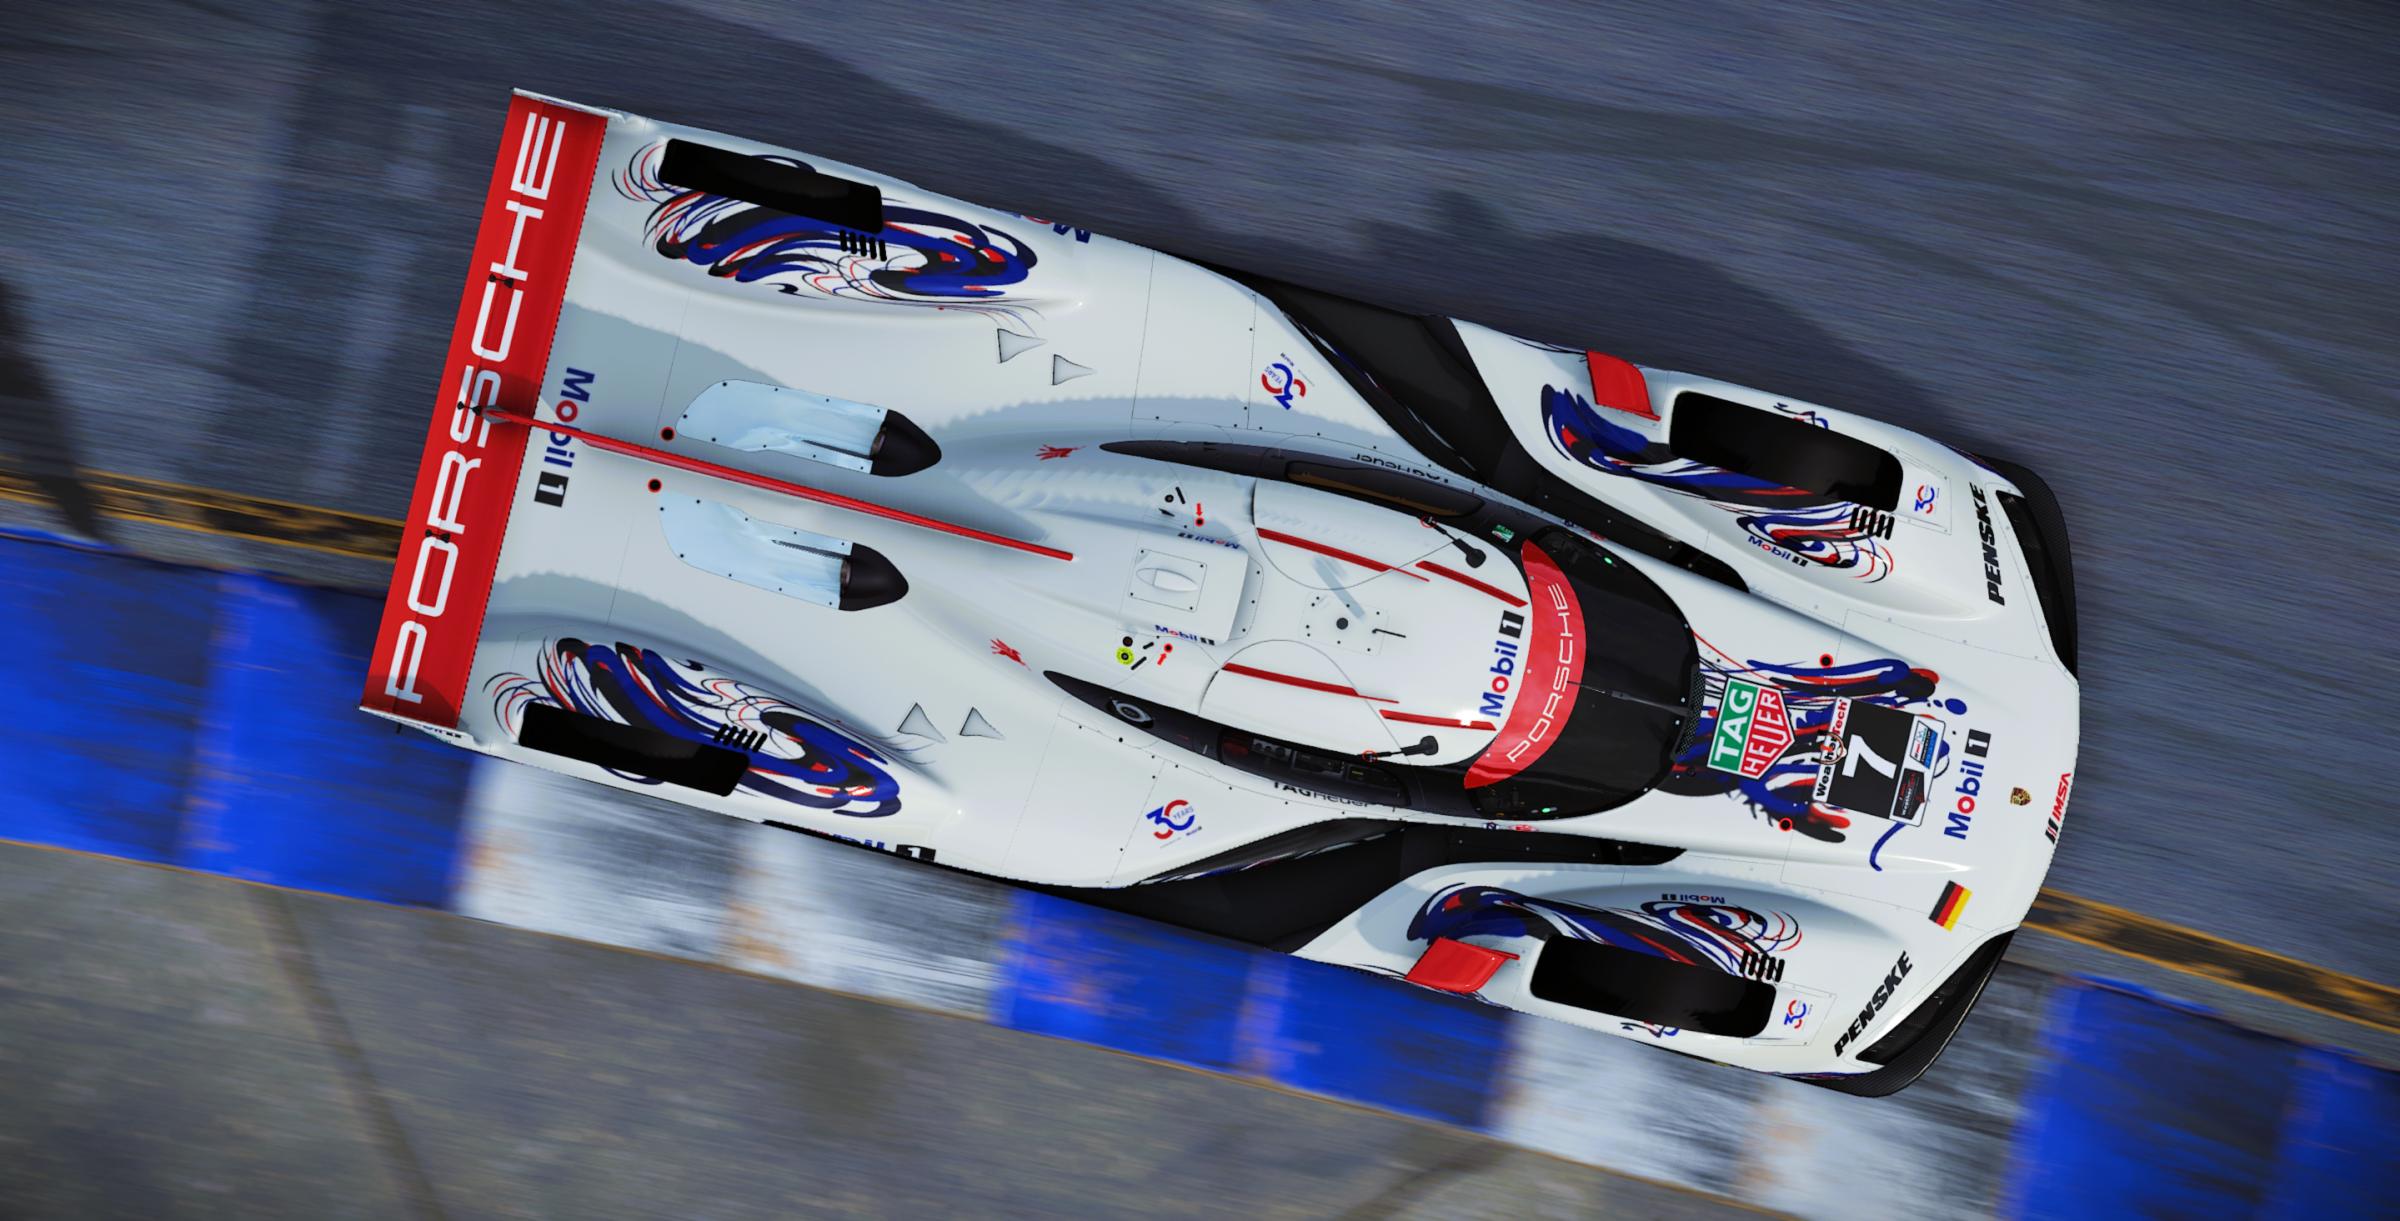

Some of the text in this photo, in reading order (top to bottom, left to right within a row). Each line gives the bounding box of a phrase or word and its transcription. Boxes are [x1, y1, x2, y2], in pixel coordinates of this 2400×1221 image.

[384, 111, 566, 704] PORSCHE
[543, 366, 596, 468] Mobil
[1262, 363, 1306, 410] 30
[1914, 484, 1935, 514] 30
[1748, 535, 1791, 560] Mobil
[1968, 481, 2005, 606] PENSKE
[1479, 640, 1518, 717] Mobil
[1505, 583, 1574, 763] PORSCHE
[1714, 688, 1754, 762] TAG
[1744, 692, 1789, 773] HEUER
[1841, 734, 1897, 779] 7
[1146, 799, 1195, 839] 30
[1943, 760, 1985, 840] Mobil
[2051, 772, 2072, 822] IMSA
[1680, 894, 1725, 904] Mobil
[1784, 1000, 1807, 1029] 30
[1834, 949, 1913, 1058] PENSKE
